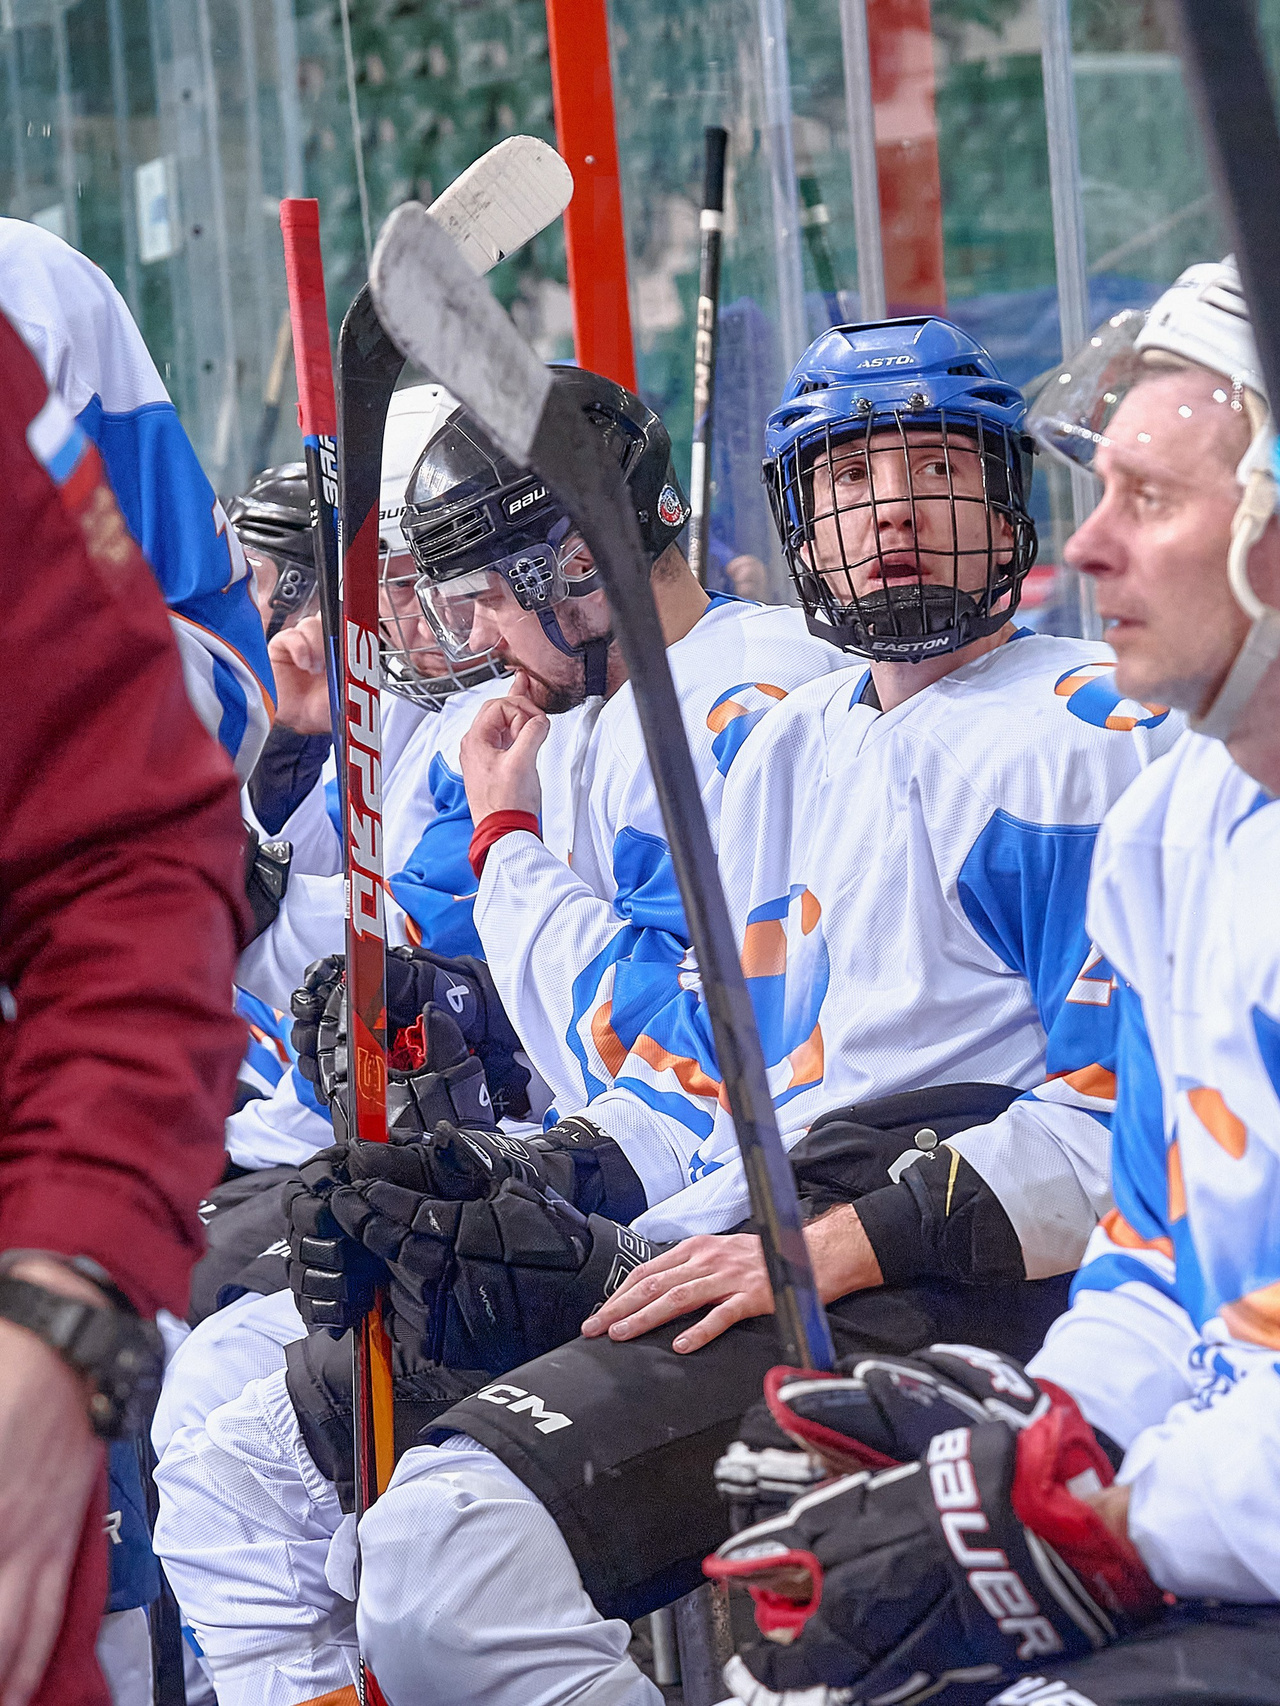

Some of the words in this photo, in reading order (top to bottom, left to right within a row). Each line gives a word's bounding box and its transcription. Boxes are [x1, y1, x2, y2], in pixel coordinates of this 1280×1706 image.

[856, 355, 915, 369] ASTO
[508, 486, 550, 516] BAU
[872, 636, 949, 652] EASTON
[462, 1383, 574, 1435] CM
